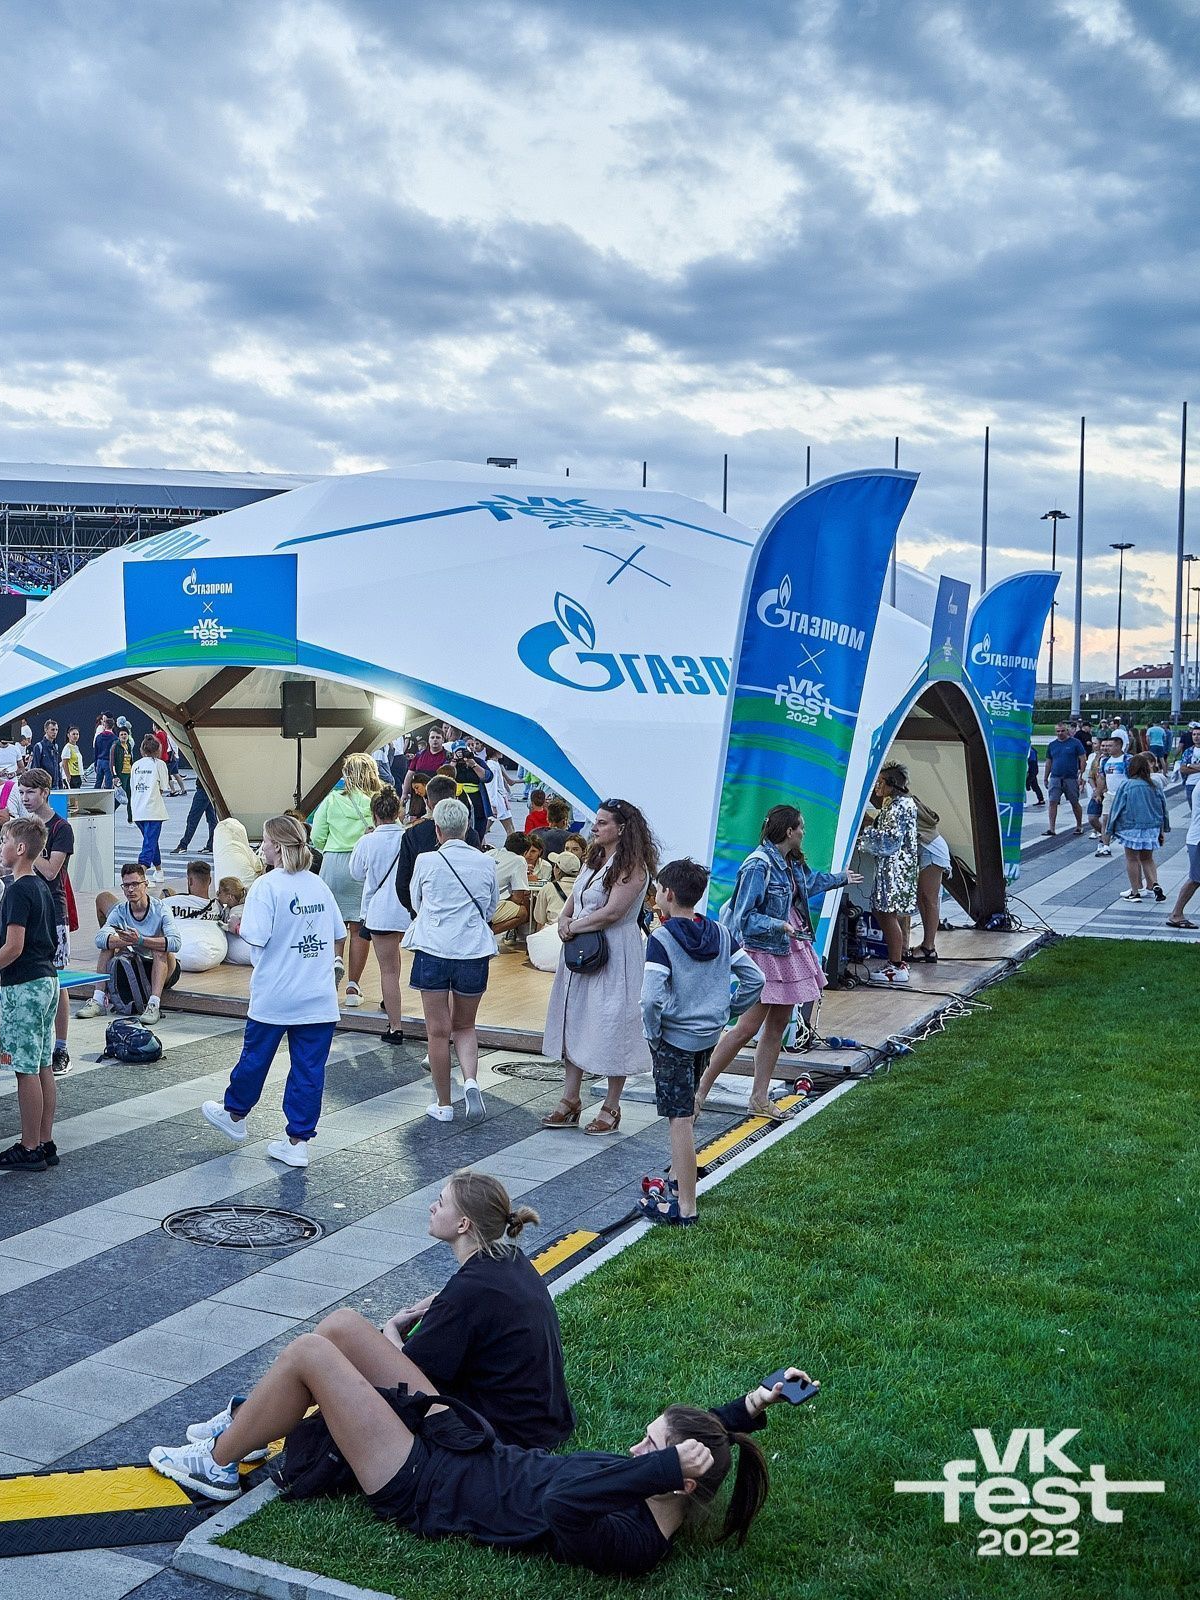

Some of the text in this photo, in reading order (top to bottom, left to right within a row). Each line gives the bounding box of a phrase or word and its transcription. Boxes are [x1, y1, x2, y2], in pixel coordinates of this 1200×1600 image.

[198, 617, 219, 629] VK
[192, 624, 227, 640] fest
[788, 611, 867, 651] ГАЗПРОМ
[200, 639, 219, 647] 2022
[788, 675, 825, 700] VK
[774, 683, 834, 720] fest
[990, 689, 1013, 702] VK
[982, 695, 1021, 712] fest
[785, 710, 818, 727] 2022
[990, 709, 1011, 718] 2022
[302, 933, 319, 944] VK
[298, 939, 325, 954] fest
[303, 951, 319, 959] 2022
